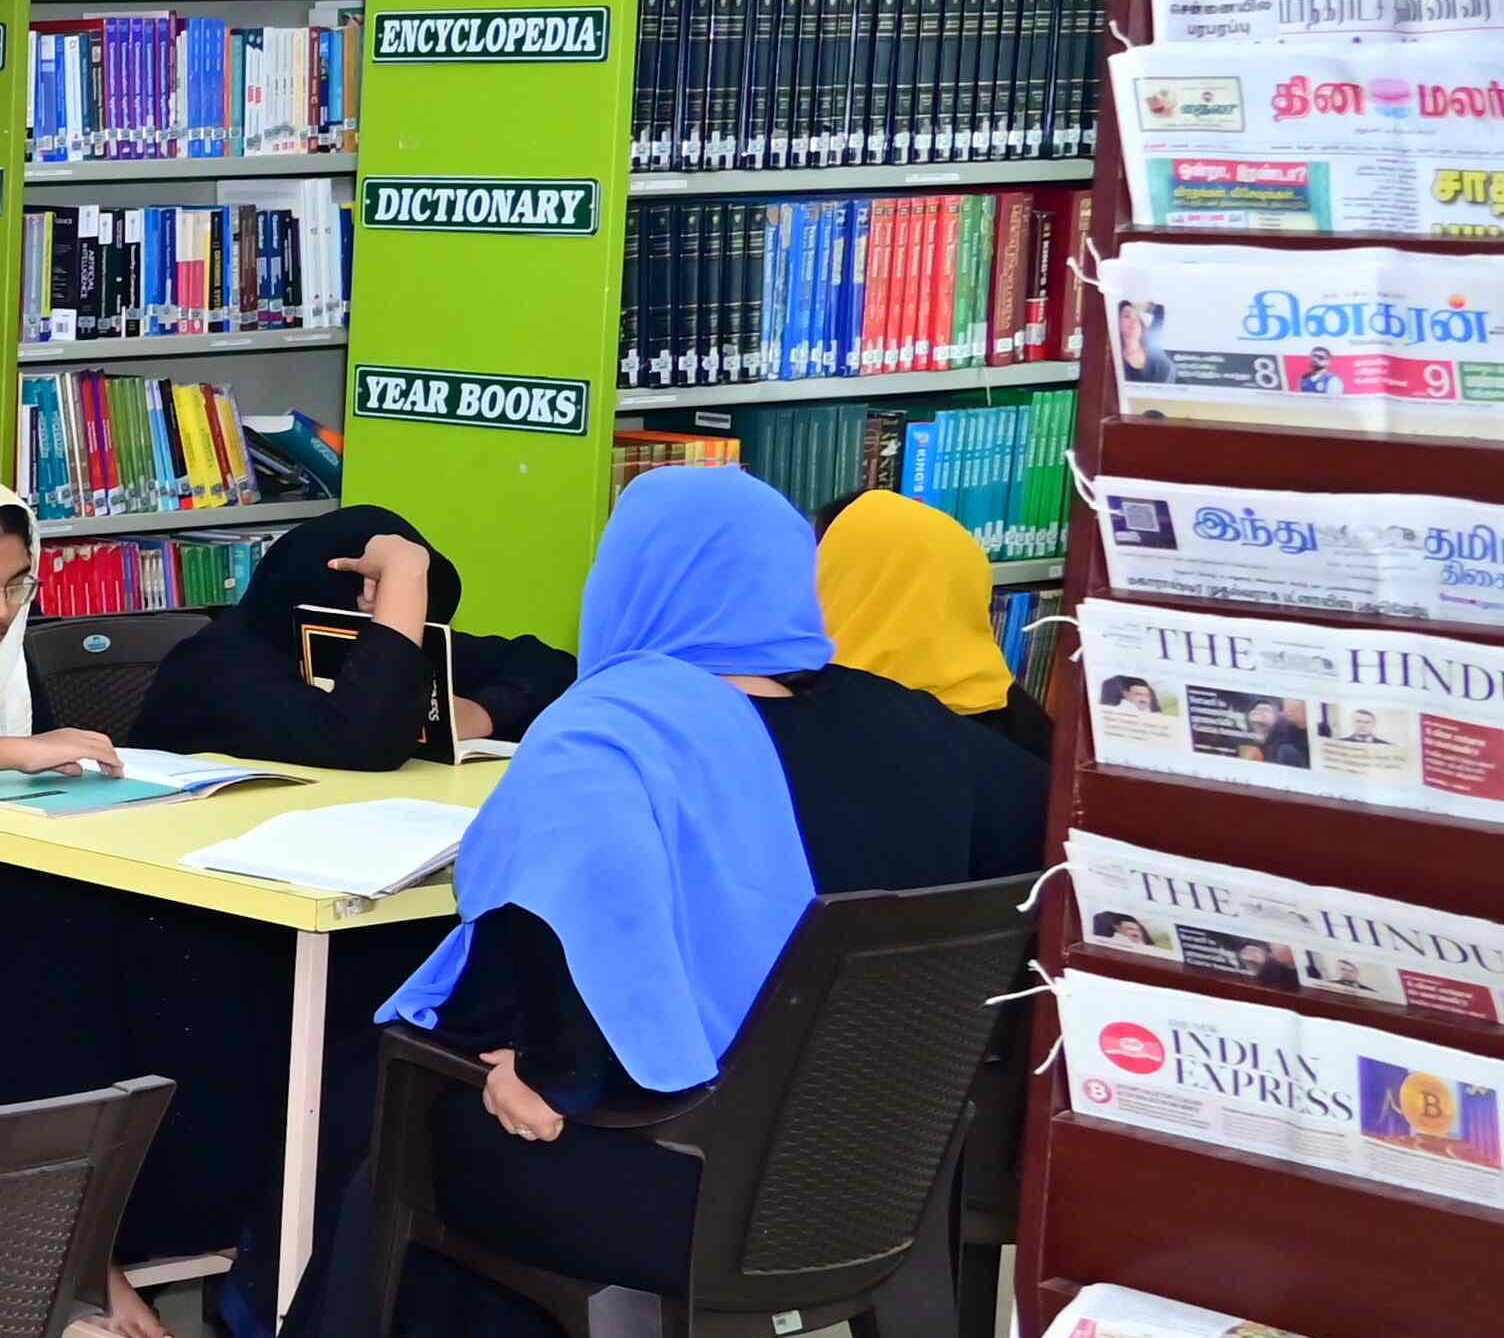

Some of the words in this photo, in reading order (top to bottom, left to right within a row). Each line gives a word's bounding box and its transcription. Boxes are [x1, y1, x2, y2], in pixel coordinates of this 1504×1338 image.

[379, 16, 597, 54] ENCYCLOPEDIA
[374, 187, 585, 225] DICTIONARY
[1238, 289, 1489, 347] தினகரன்
[1253, 358, 1279, 389] 8
[1423, 365, 1451, 398] 9
[365, 374, 450, 414] YEAR
[455, 381, 578, 425] BOOKS
[1424, 524, 1504, 562] தமி
[1146, 625, 1257, 672] THE
[1348, 648, 1504, 703] HIND
[1130, 868, 1240, 919] THE
[1170, 1028, 1321, 1086] INDIAN
[1177, 1056, 1355, 1123] EXPRESS
